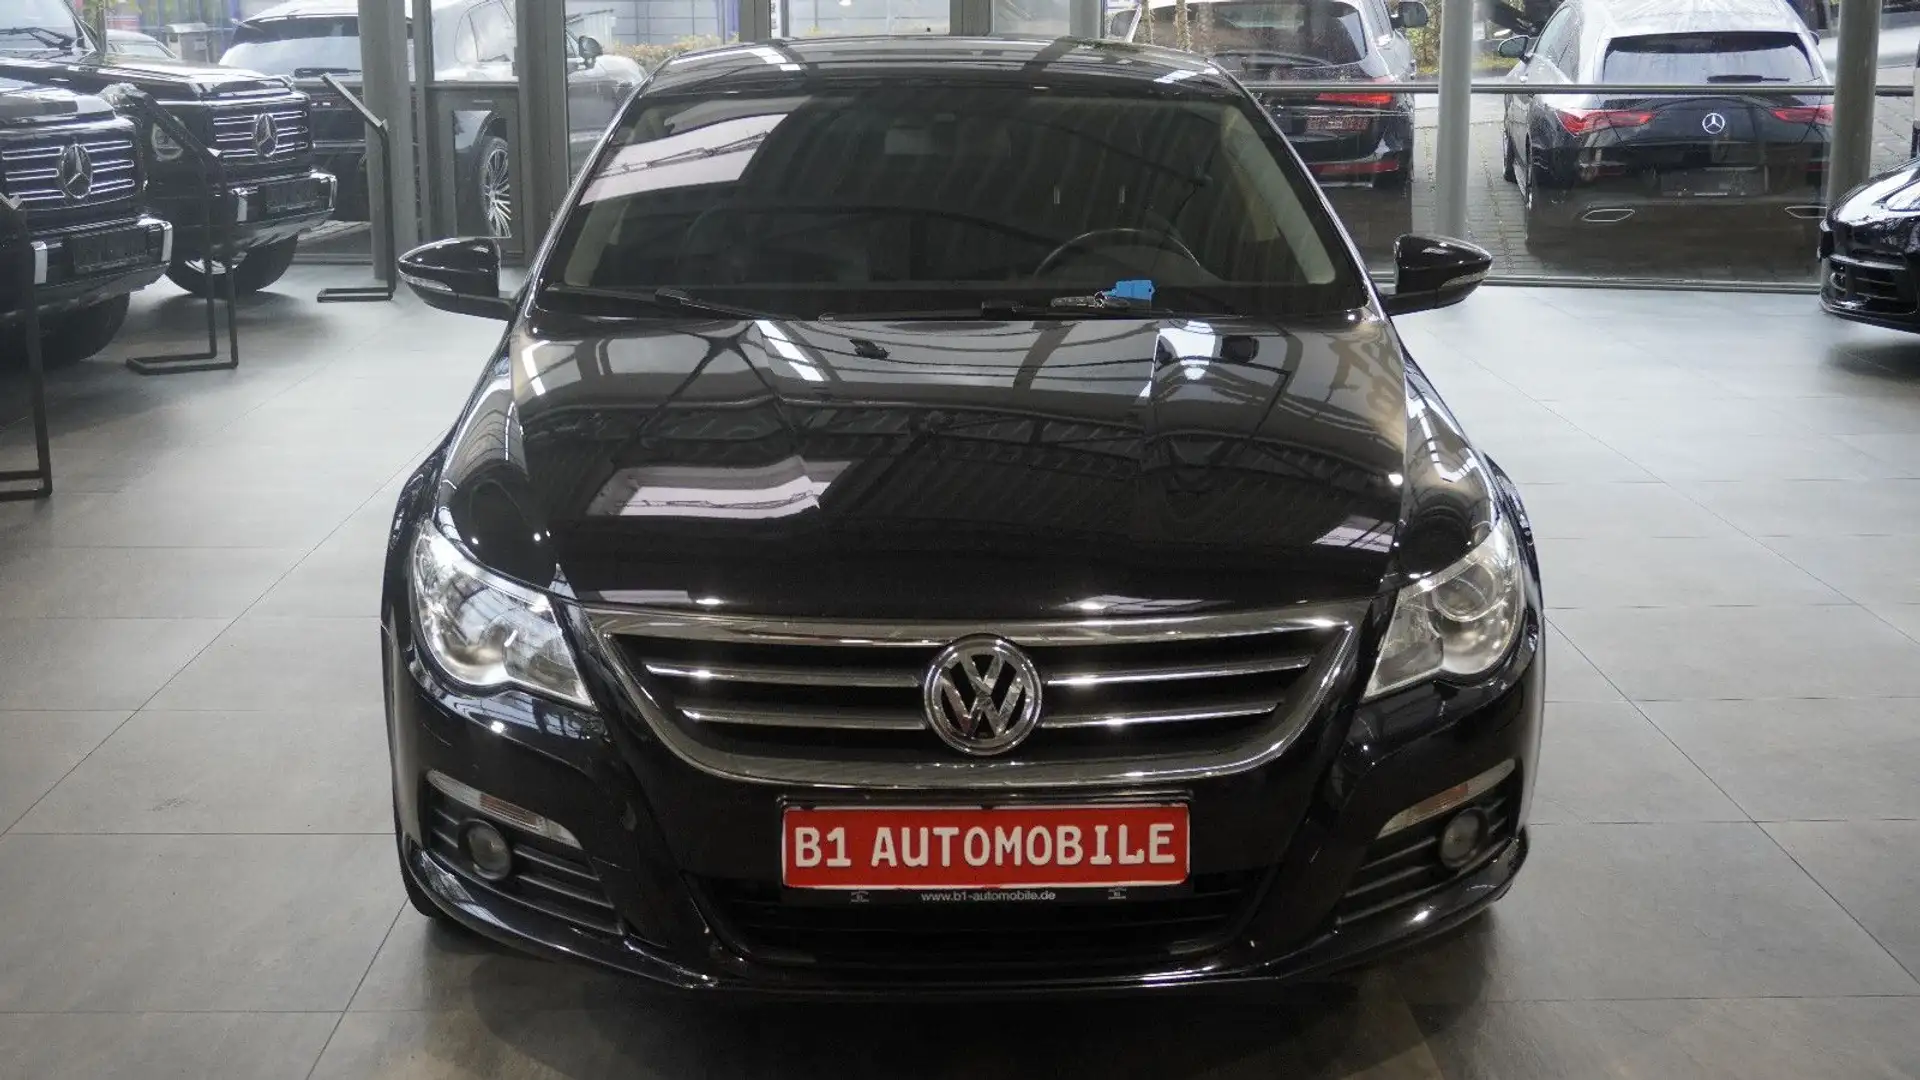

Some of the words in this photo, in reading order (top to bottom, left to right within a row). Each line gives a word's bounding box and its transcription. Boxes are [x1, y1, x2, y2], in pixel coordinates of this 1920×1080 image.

[931, 643, 1036, 746] VW
[795, 826, 852, 868] B1
[871, 824, 1176, 867] AUTOMOBILE
[920, 890, 1057, 902] www.b1-automobile.de
